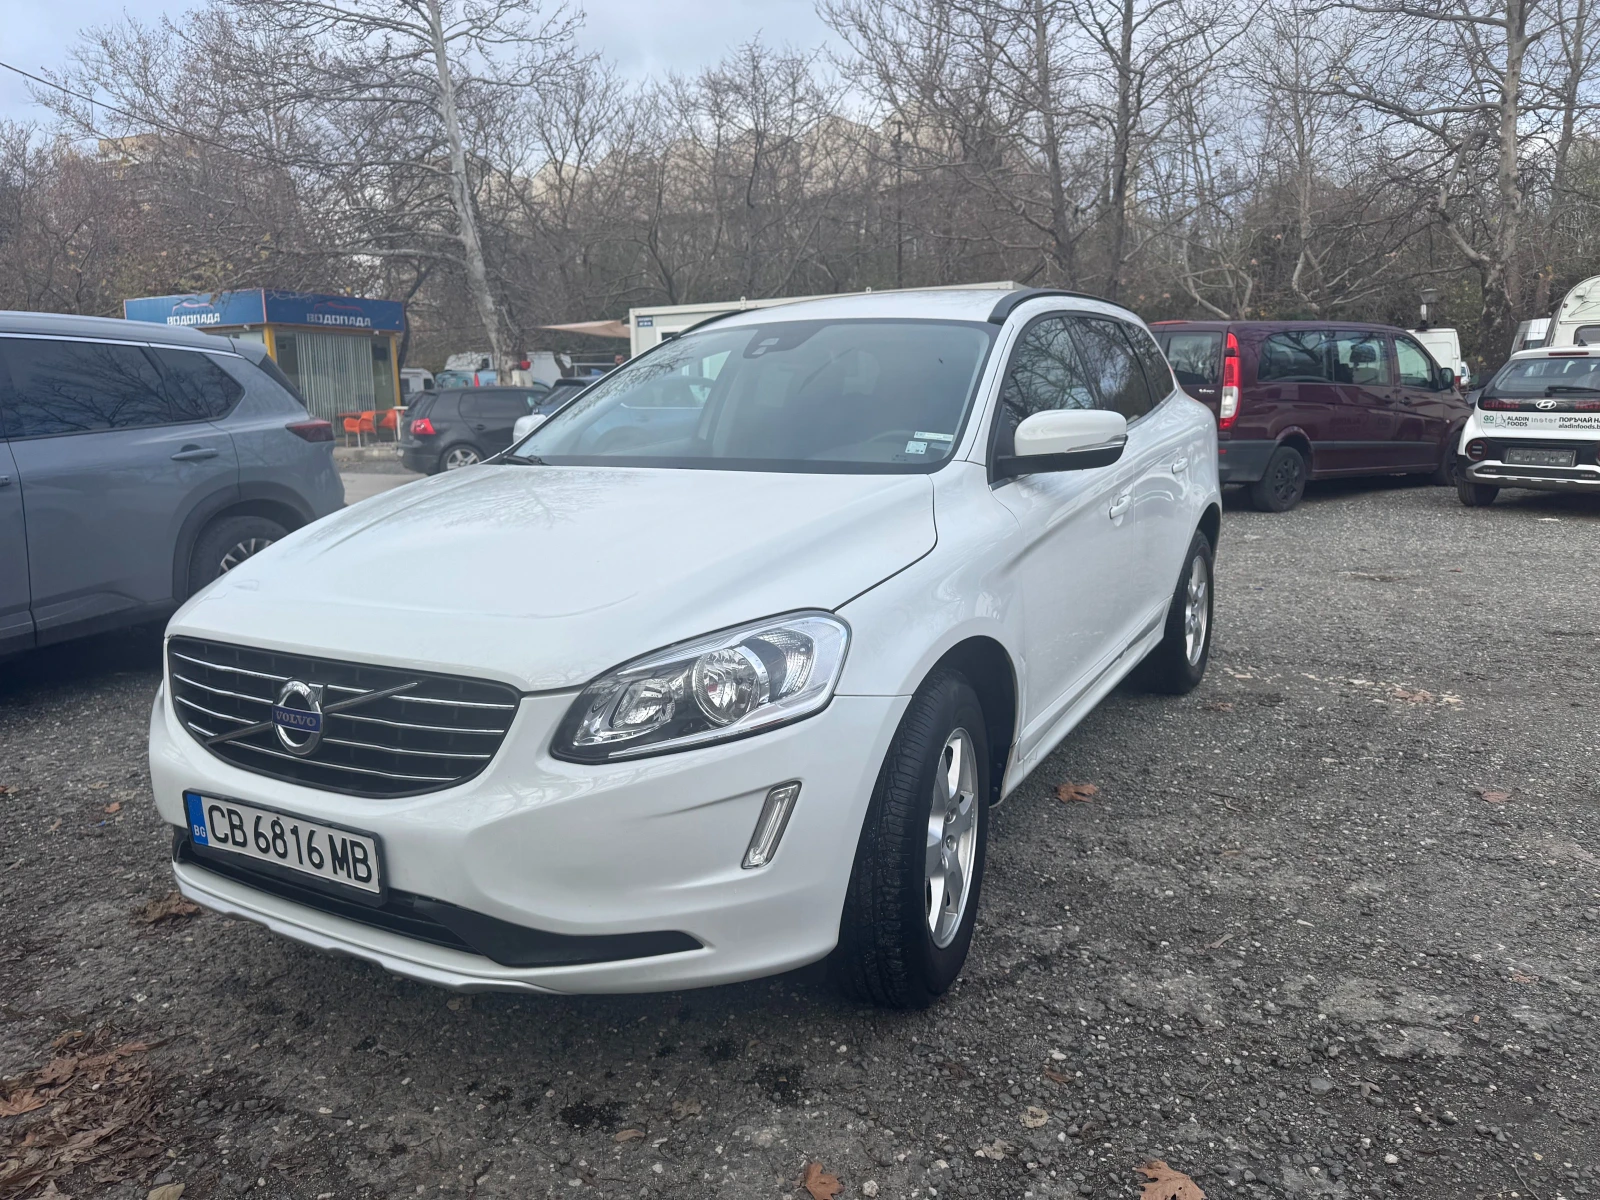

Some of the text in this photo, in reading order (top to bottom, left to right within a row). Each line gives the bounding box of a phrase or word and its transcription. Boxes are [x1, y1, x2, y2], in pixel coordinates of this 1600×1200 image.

[167, 312, 220, 326] ВОДОПАДА
[306, 313, 371, 327] ВОДОПАДА
[276, 711, 316, 727] VOLVO
[193, 824, 207, 838] BG
[208, 804, 373, 883] CB 6816 MB
